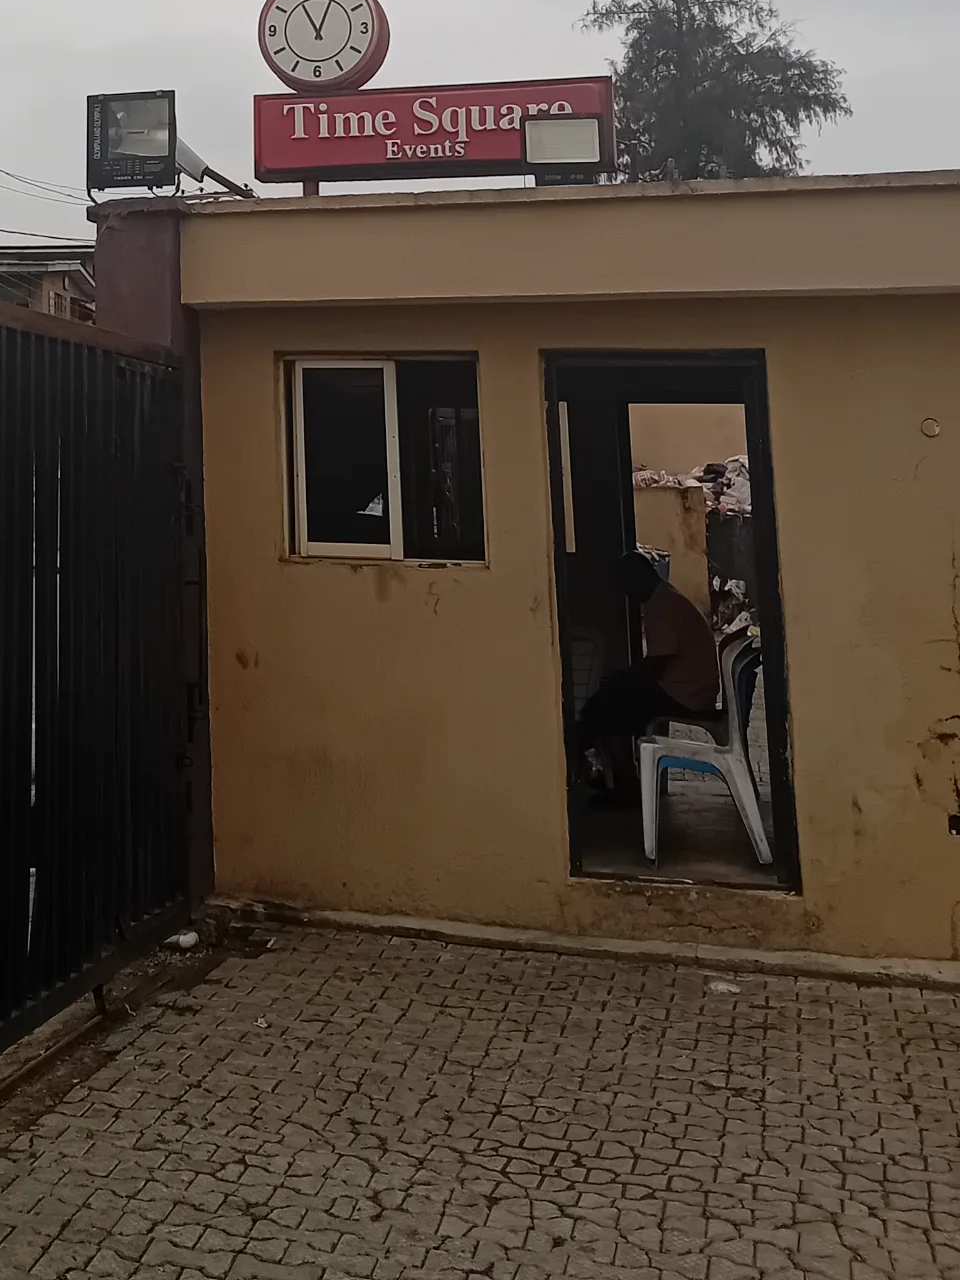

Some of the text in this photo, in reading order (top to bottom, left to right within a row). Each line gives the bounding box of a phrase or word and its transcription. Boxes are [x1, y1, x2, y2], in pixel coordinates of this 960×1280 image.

[268, 24, 277, 37] 9
[360, 21, 369, 34] 3
[312, 65, 322, 78] 6
[283, 102, 397, 140] Time
[385, 139, 465, 160] Events
